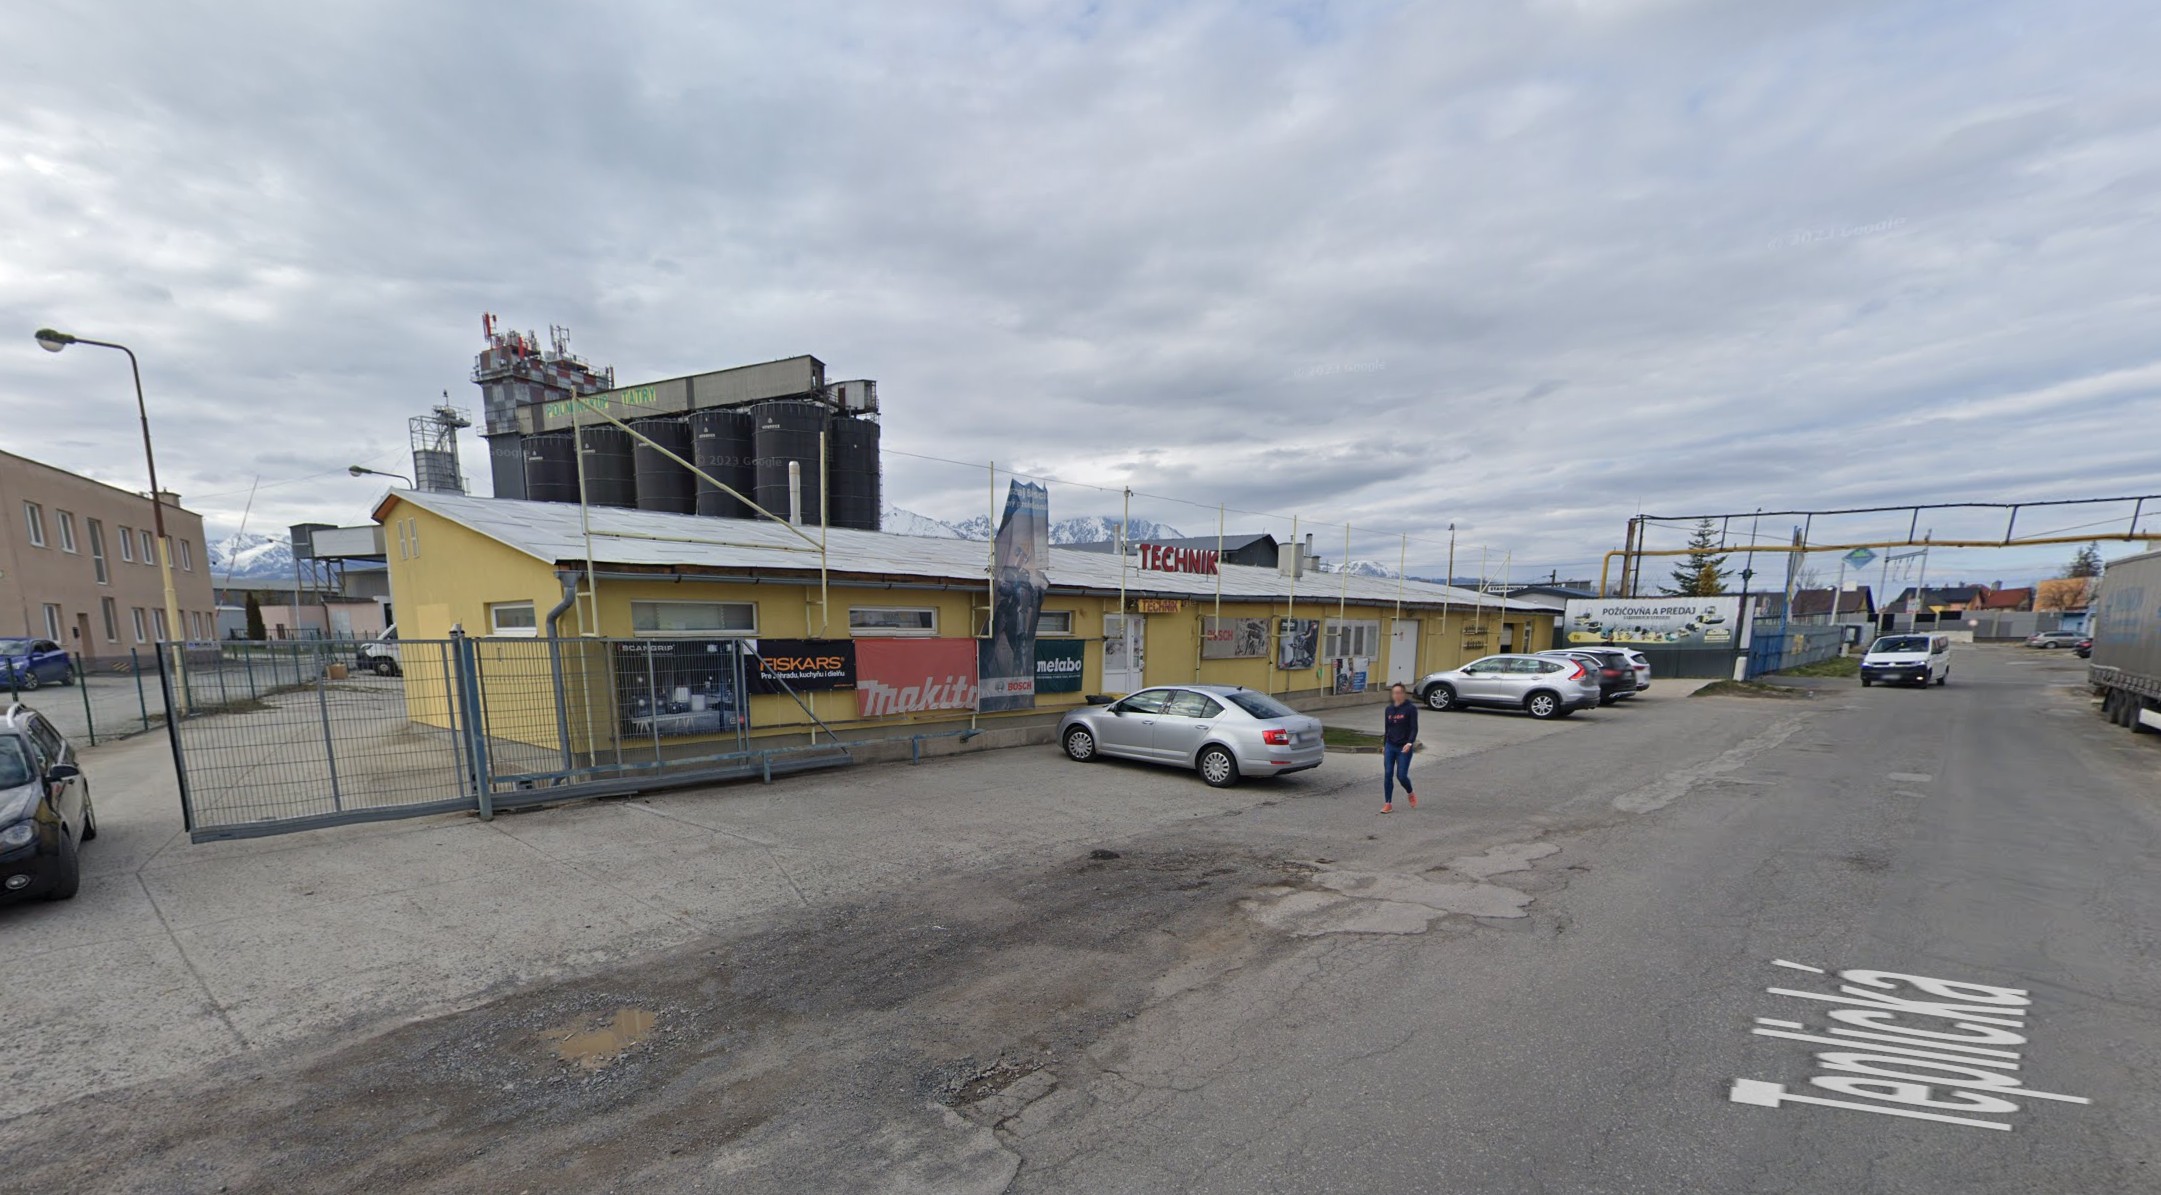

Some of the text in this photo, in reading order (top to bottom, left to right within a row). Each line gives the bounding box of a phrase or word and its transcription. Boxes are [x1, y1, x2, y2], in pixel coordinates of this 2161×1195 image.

[622, 387, 657, 406] TATRY
[1140, 543, 1219, 575] TECHNIK
[1143, 600, 1179, 613] TECHNIK
[1602, 606, 1696, 616] POŽIČOVŇA A PREDAJ
[760, 656, 842, 672] FISKARS
[1036, 657, 1082, 672] metabo
[761, 672, 772, 680] Pre
[773, 671, 800, 680] hradu,
[1007, 681, 1032, 691] BOSCH
